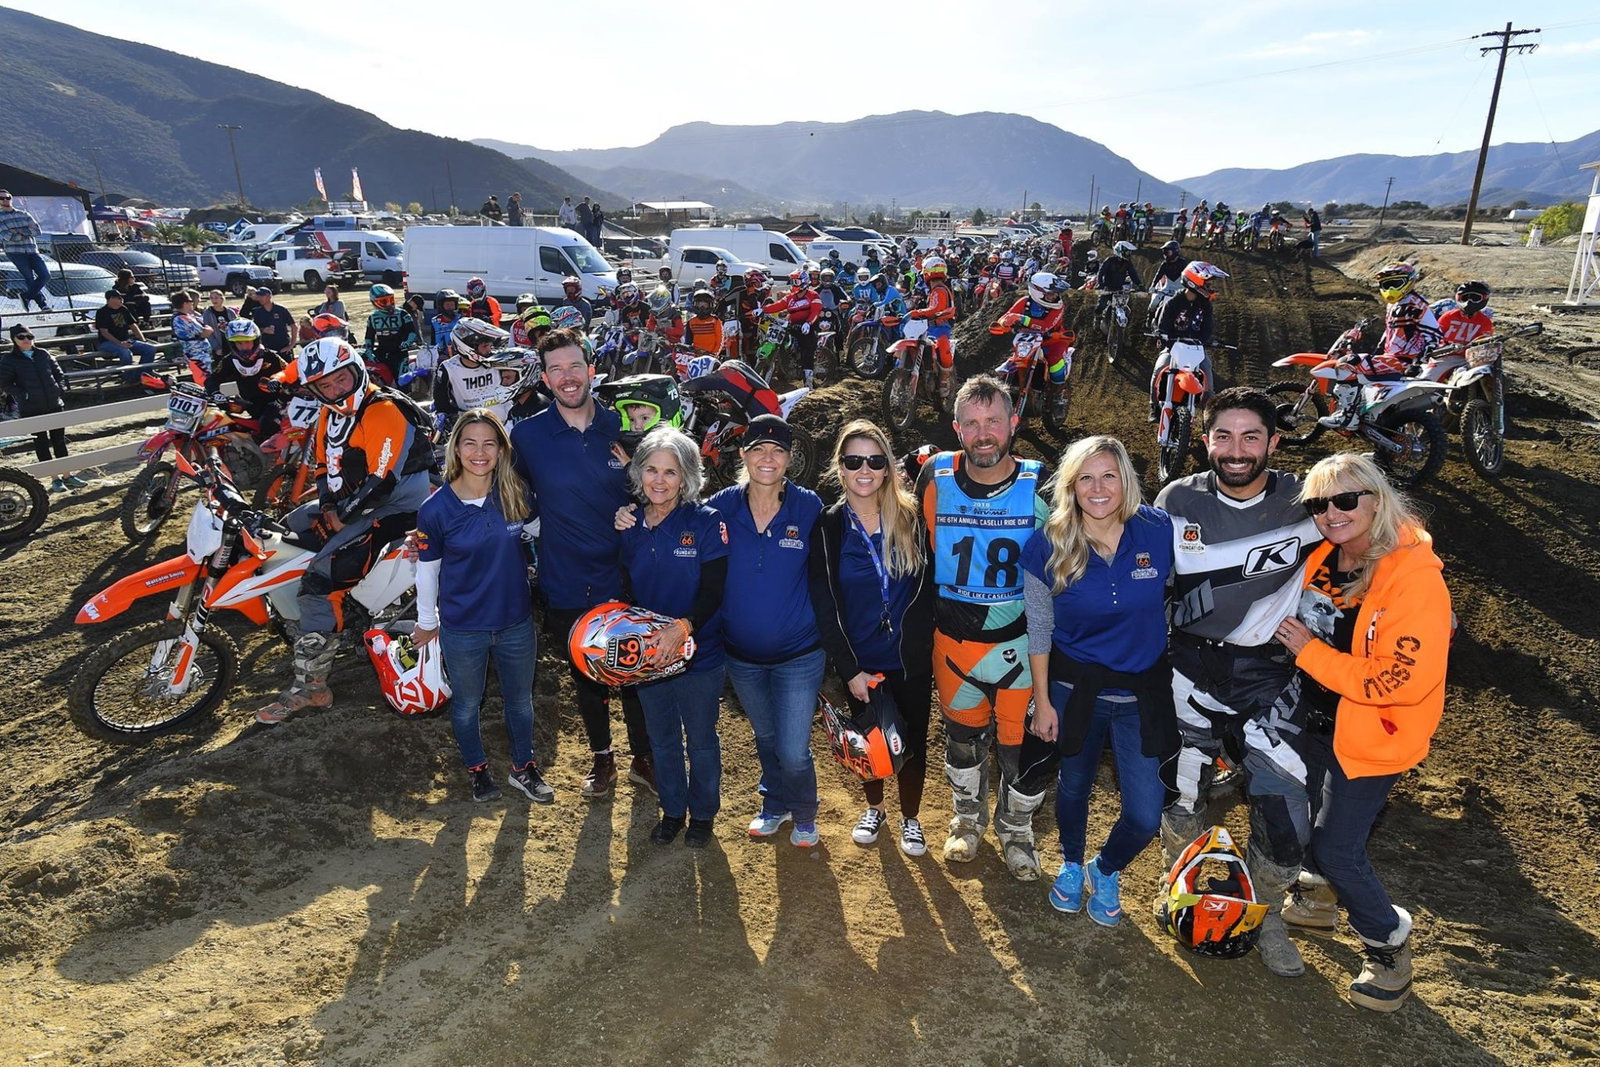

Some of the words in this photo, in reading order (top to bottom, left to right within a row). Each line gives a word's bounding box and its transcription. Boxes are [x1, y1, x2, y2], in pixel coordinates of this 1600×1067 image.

[373, 315, 400, 329] FXR
[1445, 320, 1482, 343] FLY
[462, 373, 494, 390] THOR
[170, 397, 199, 414] 0101
[681, 536, 693, 545] 66
[1184, 531, 1197, 540] 66
[951, 536, 1021, 588] 18
[957, 588, 971, 597] RIDE
[972, 590, 986, 599] LIKE
[619, 640, 639, 666] 66
